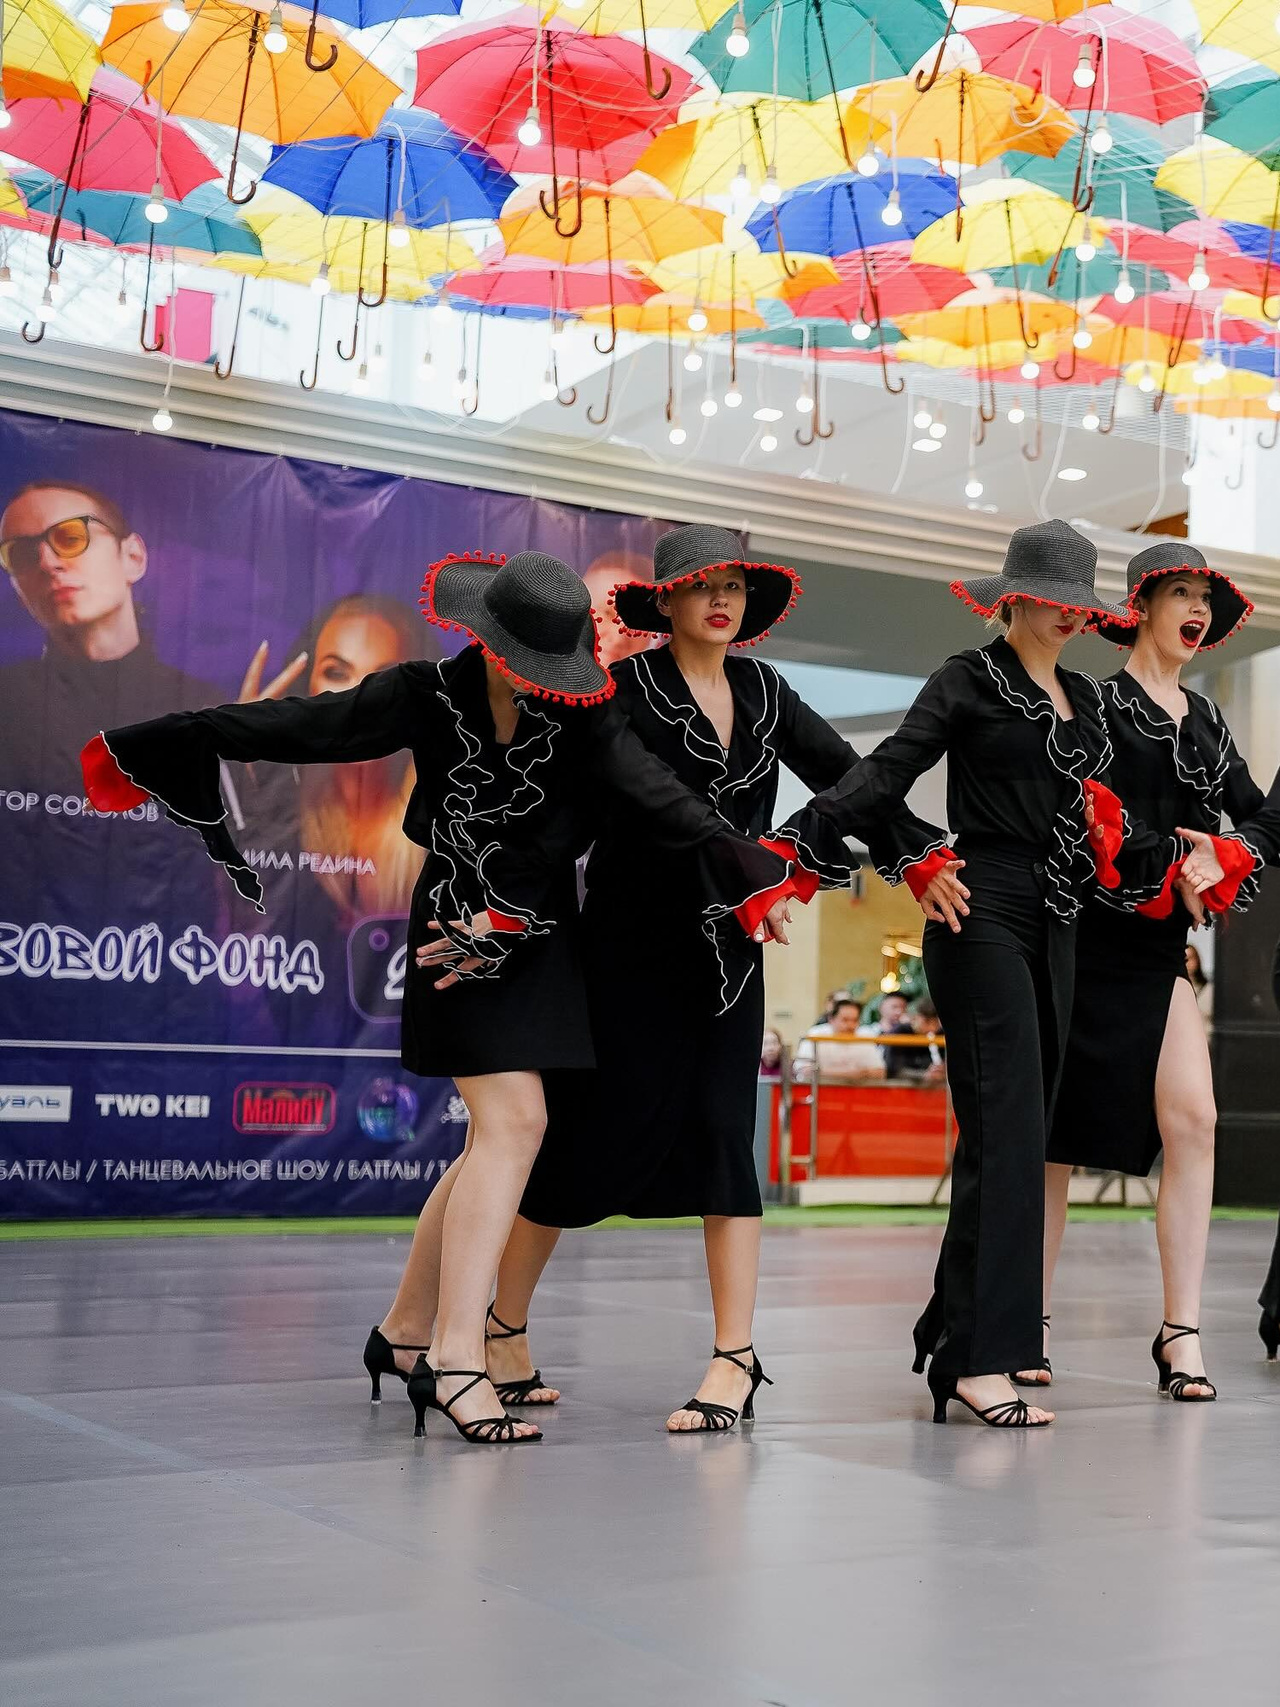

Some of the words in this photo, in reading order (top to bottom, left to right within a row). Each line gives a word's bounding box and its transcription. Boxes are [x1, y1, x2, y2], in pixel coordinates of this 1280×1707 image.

[298, 851, 377, 876] РЕДИНА
[168, 924, 325, 995] ФОНД
[95, 1093, 161, 1118] TWO
[165, 1094, 211, 1118] KEI
[103, 1159, 273, 1183] ТАНЦЕВАЛЬНОЕ
[276, 1159, 330, 1181] ШОУ
[348, 1159, 421, 1181] БАТТЛЫ
